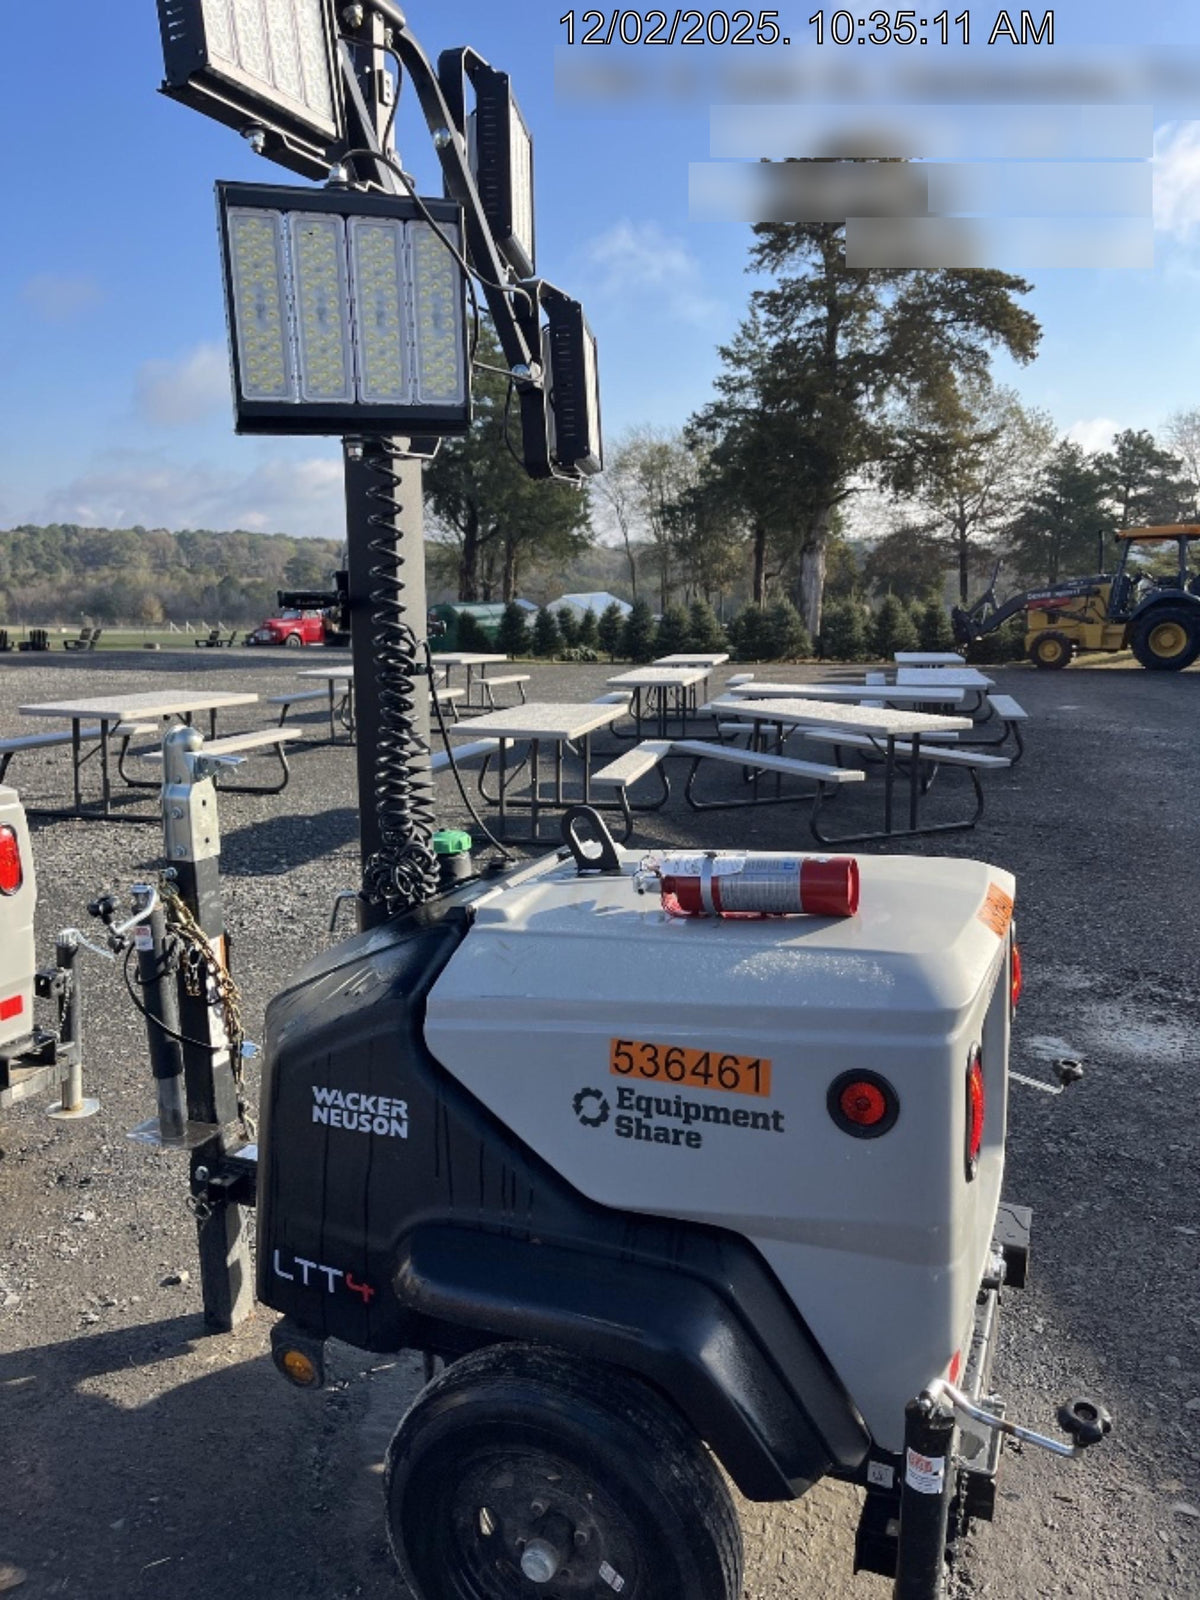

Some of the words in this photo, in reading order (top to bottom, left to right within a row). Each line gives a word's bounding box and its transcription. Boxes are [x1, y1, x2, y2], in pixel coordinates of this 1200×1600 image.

[612, 1039, 763, 1093] 536461
[311, 1085, 409, 1119] WACKER
[311, 1105, 409, 1139] NEUSON
[616, 1086, 785, 1133] Equipment
[614, 1114, 703, 1149] Share
[273, 1248, 375, 1304] LTT4
